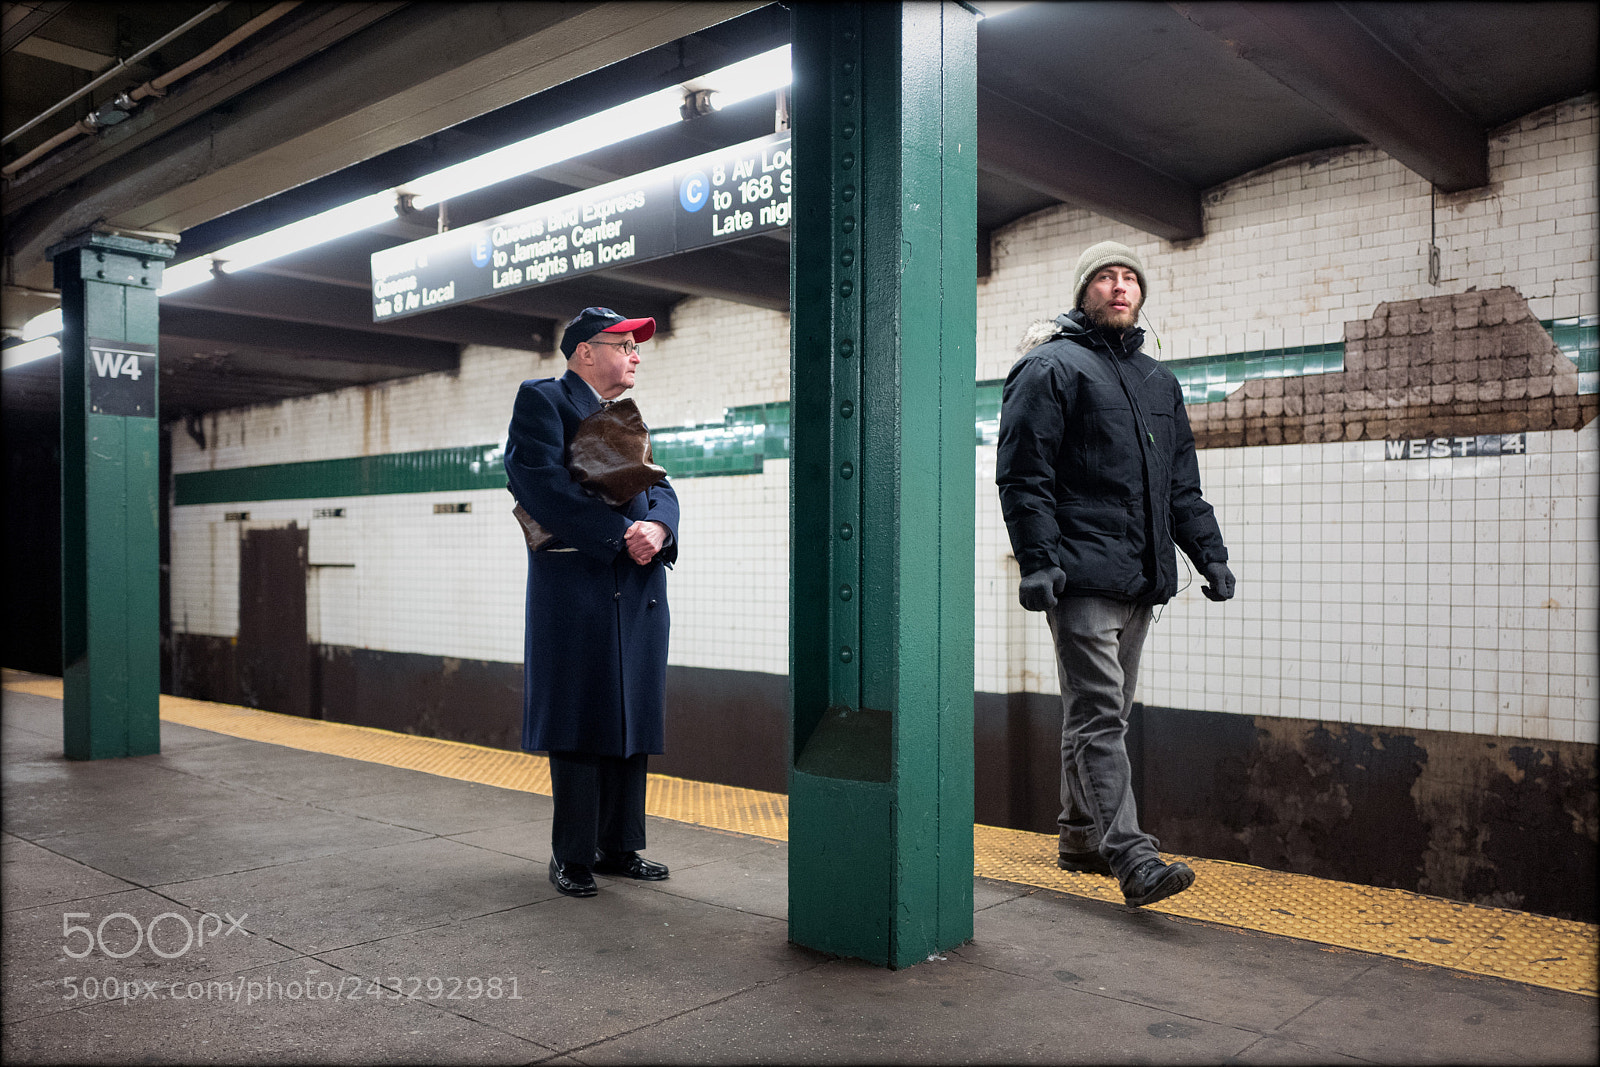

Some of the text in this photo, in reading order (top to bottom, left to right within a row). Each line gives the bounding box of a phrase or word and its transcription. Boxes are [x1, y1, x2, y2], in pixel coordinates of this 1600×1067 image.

[712, 163, 726, 187] 8
[731, 158, 756, 182] Av
[686, 179, 703, 204] C
[712, 190, 733, 211] to
[738, 174, 774, 204] 168
[492, 220, 545, 248] Queens
[582, 190, 646, 223] Express
[712, 209, 754, 237] Late
[493, 219, 623, 268] to Jamaica Center
[492, 234, 635, 289] Late nights via local
[393, 294, 404, 313] 8
[405, 291, 421, 311] Av
[422, 280, 455, 306] Local
[92, 350, 142, 381] W4
[1386, 433, 1525, 460] WEST 4
